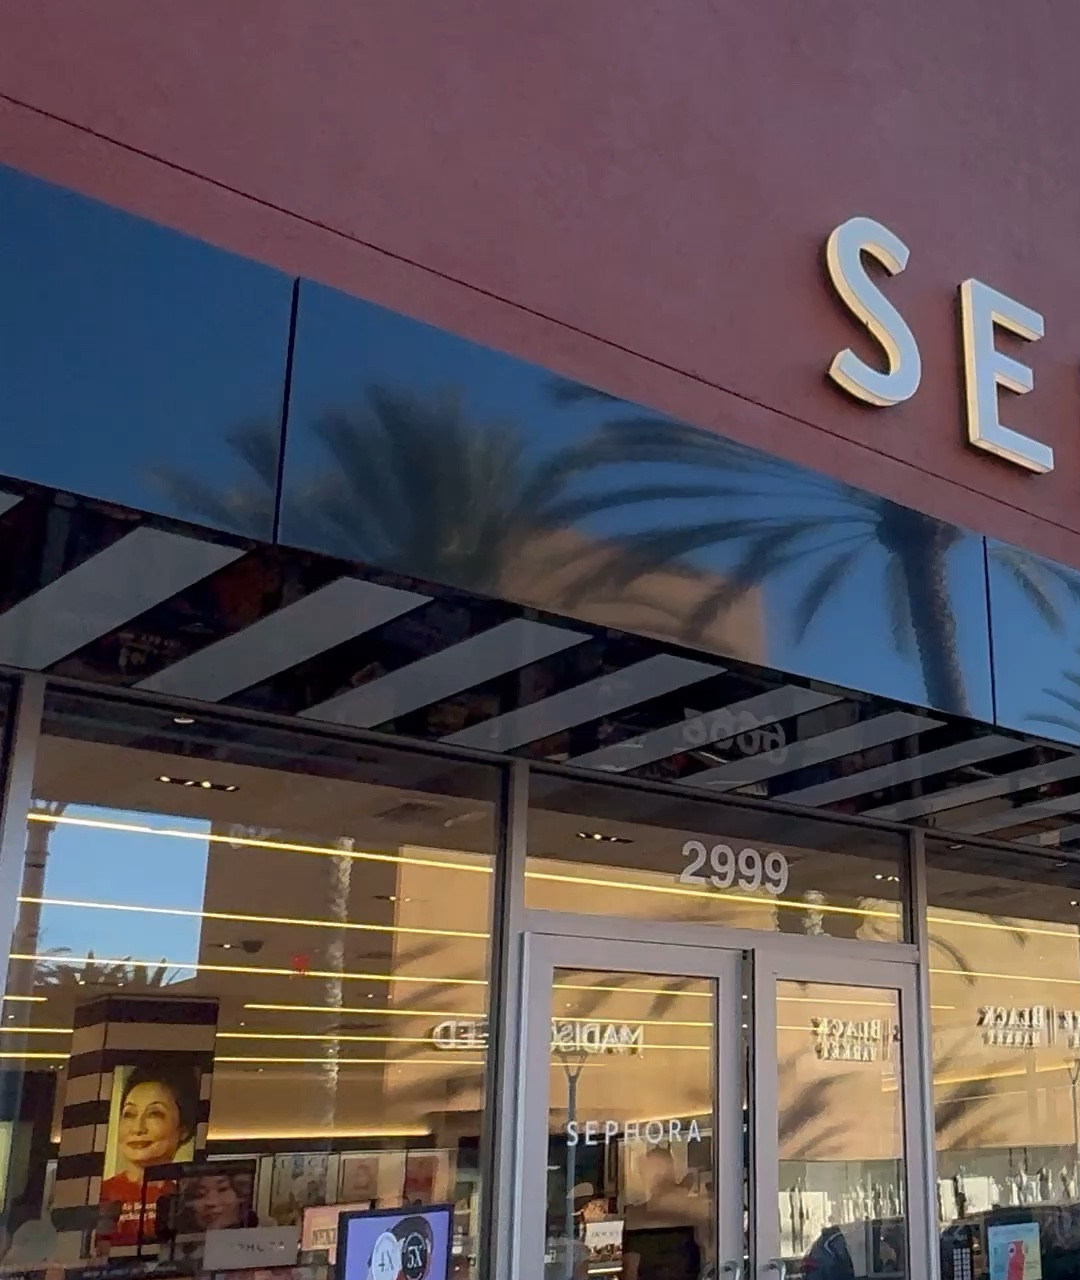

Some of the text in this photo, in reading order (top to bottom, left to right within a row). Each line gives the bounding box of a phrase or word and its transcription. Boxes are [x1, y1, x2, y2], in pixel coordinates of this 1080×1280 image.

[680, 840, 788, 894] 2999
[567, 1119, 701, 1146] SEPHORA
[407, 1244, 423, 1269] 5X
